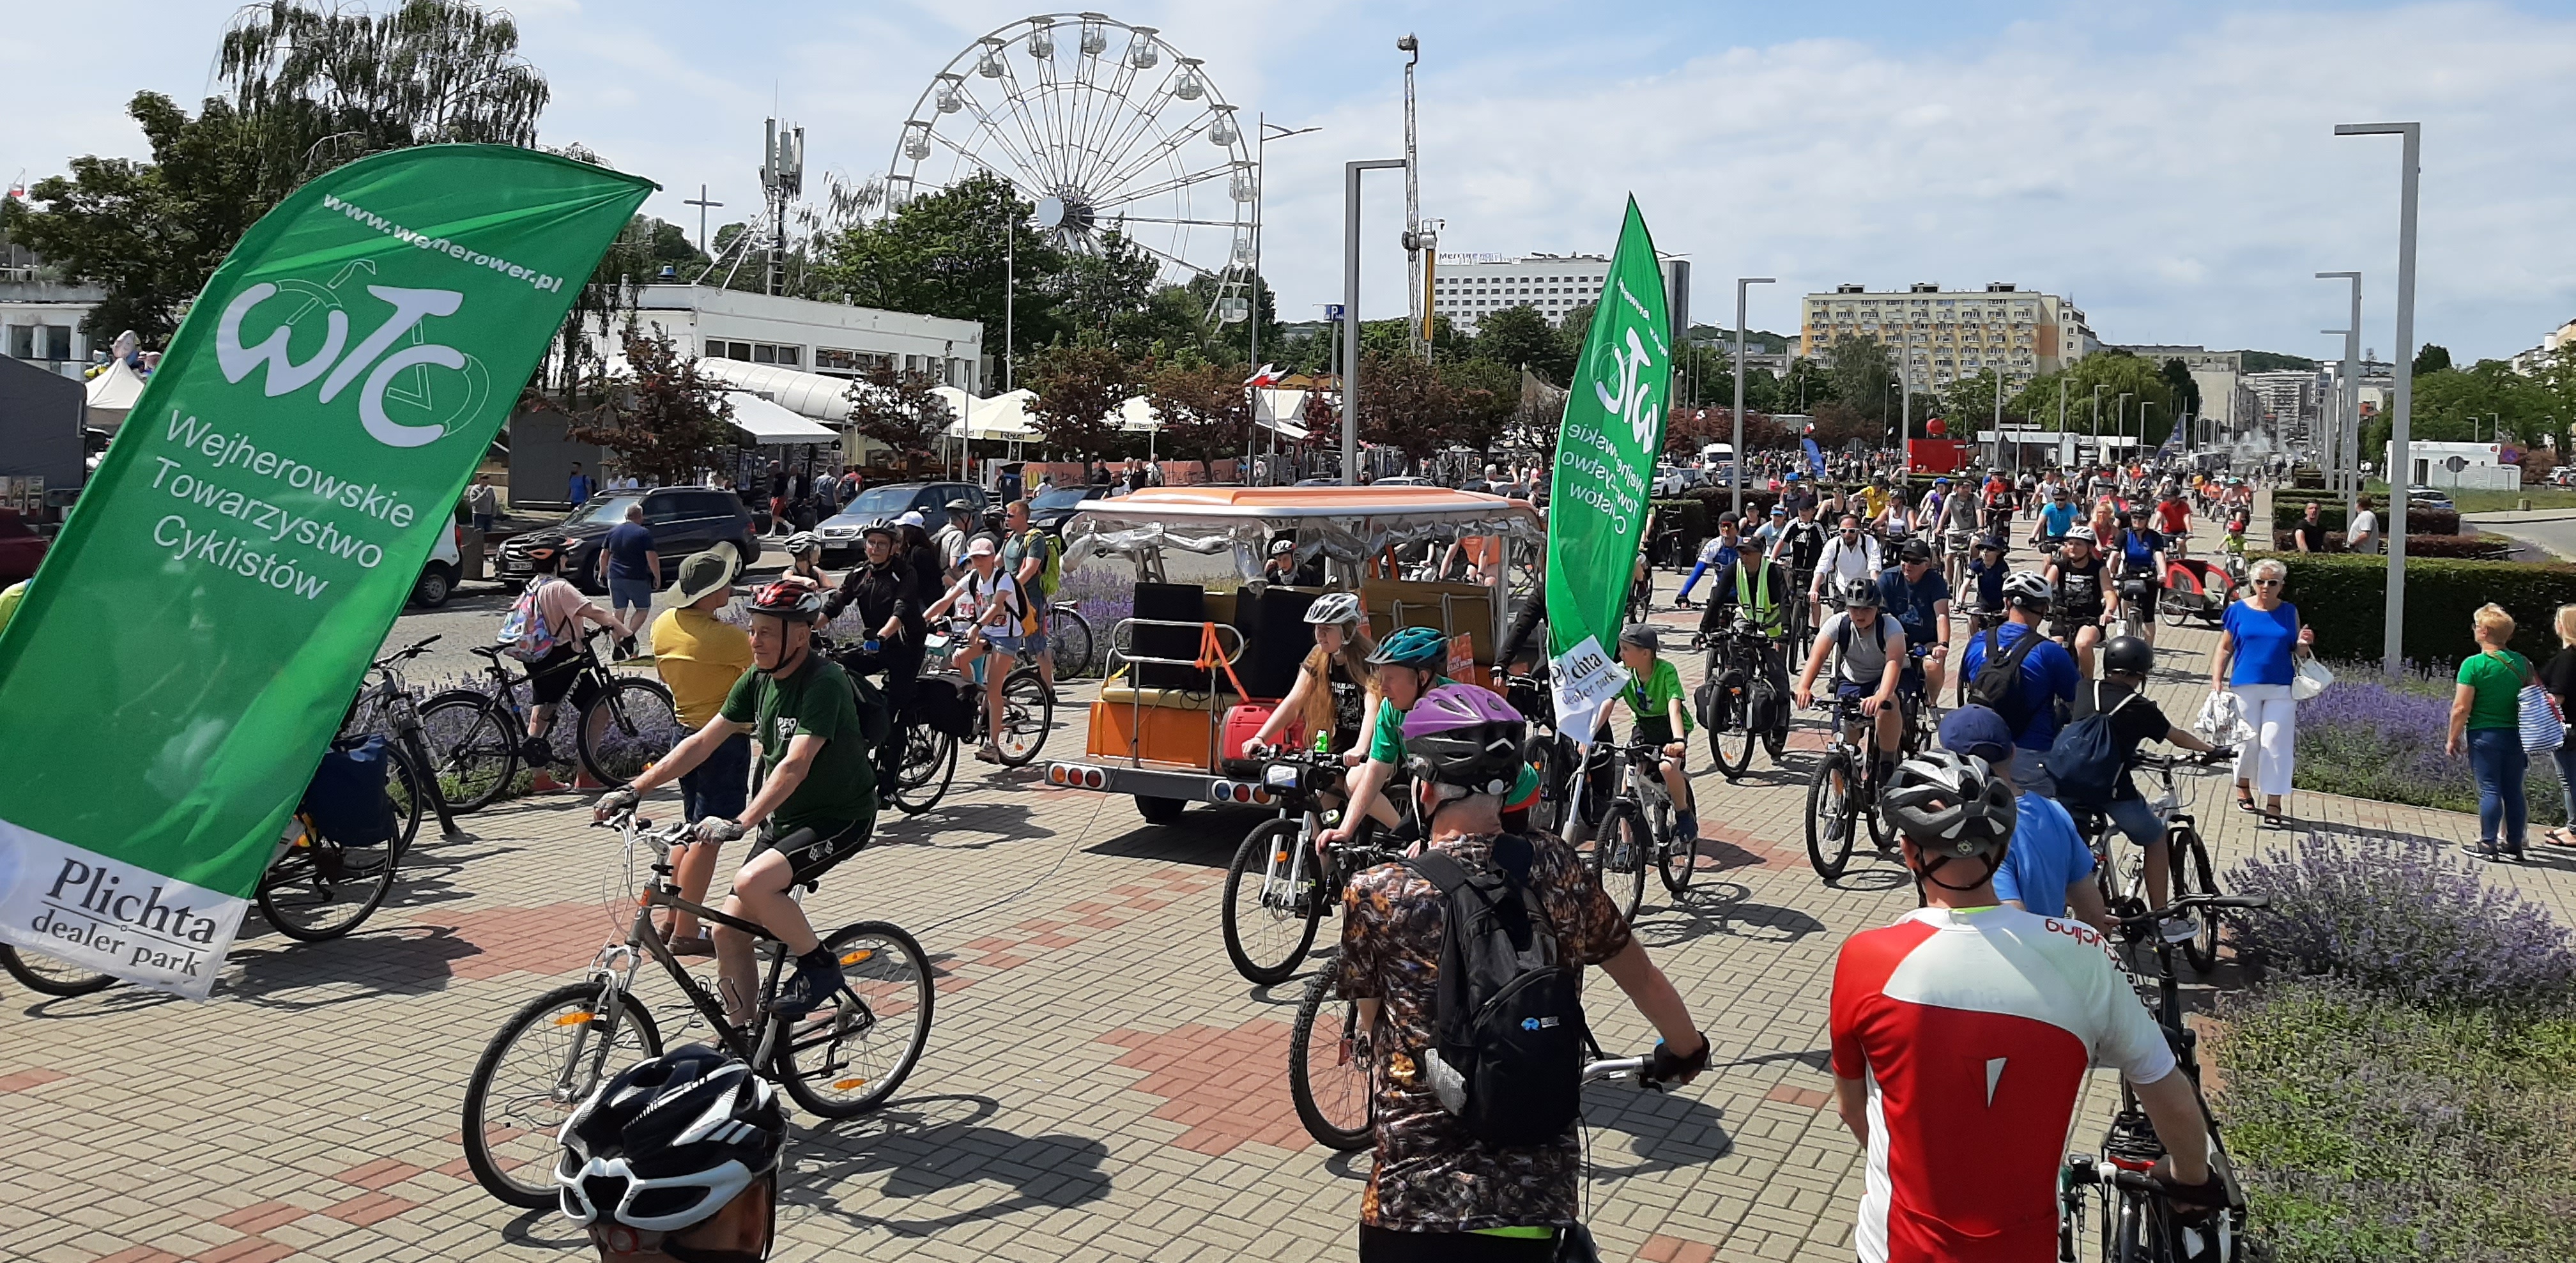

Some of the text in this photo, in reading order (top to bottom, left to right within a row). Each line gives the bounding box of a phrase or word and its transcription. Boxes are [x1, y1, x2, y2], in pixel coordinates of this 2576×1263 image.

[1331, 305, 1338, 320] P
[167, 410, 415, 528] Wejherowskie
[152, 456, 383, 569] Towarzystwo
[153, 515, 329, 600] Cyklistów
[1561, 670, 1618, 705] dealer park
[31, 908, 202, 978] dealer park
[45, 857, 217, 945] Plichta
